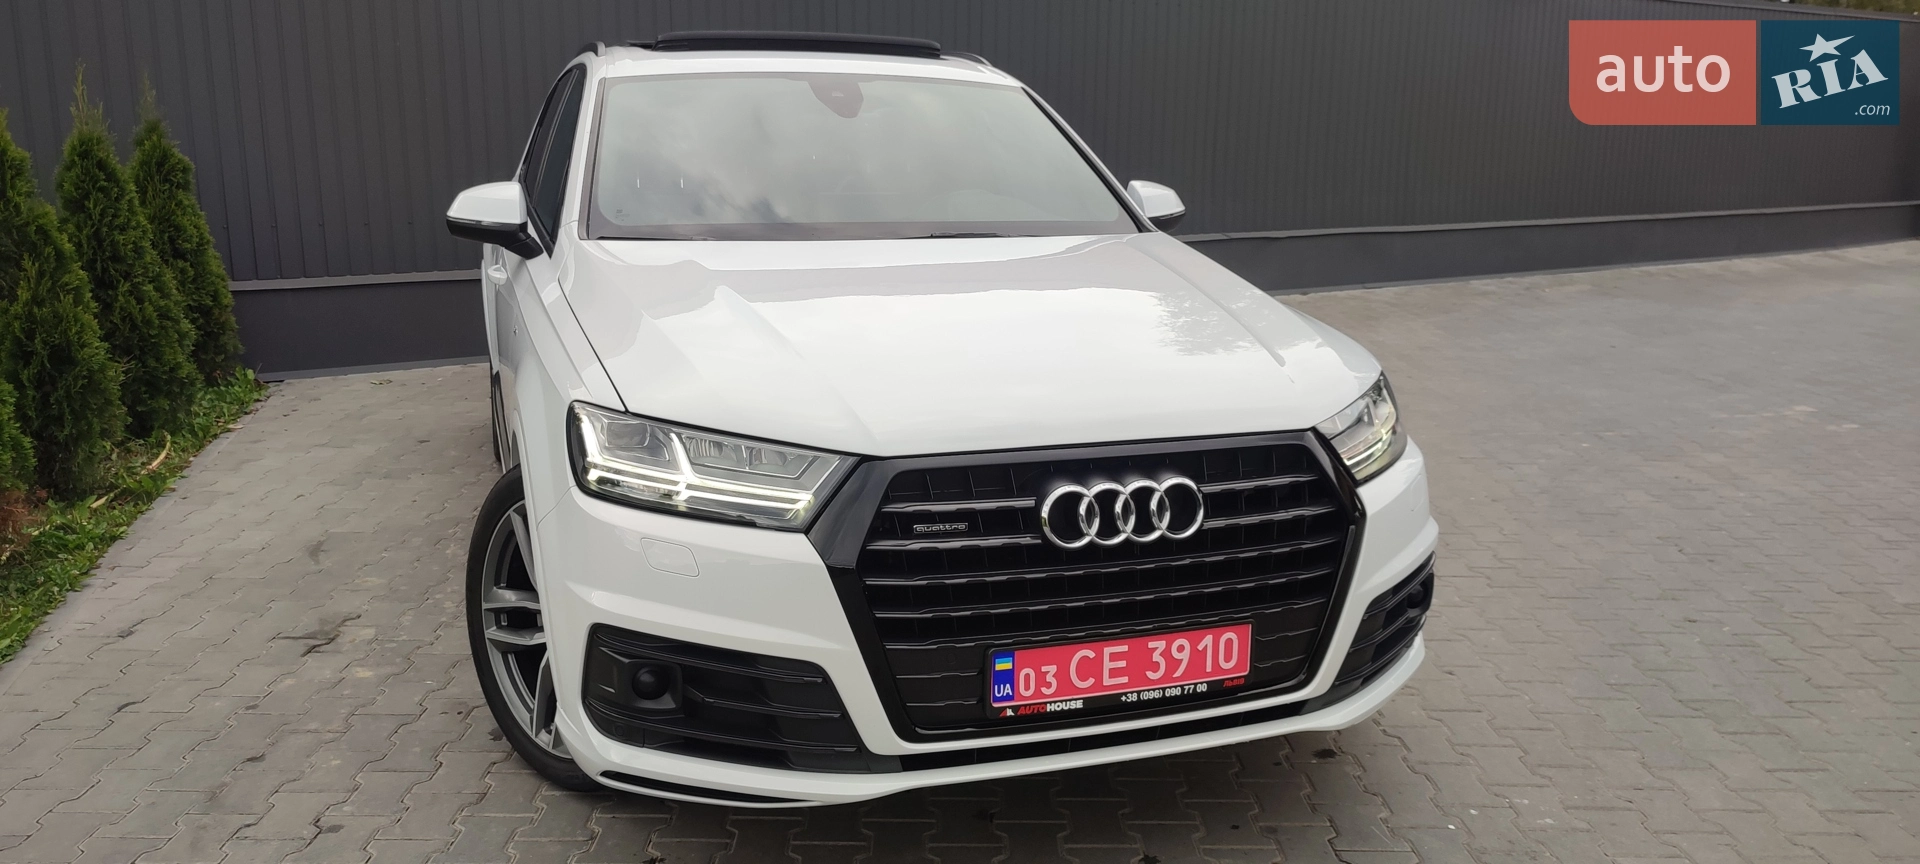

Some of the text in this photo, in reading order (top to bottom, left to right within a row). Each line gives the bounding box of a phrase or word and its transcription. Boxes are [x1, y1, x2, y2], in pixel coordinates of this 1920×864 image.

[916, 524, 966, 532] quattro
[1019, 632, 1239, 697] 03 CE 3910
[994, 683, 1013, 697] UA
[1120, 682, 1208, 702] +38 (096) 090 77 00
